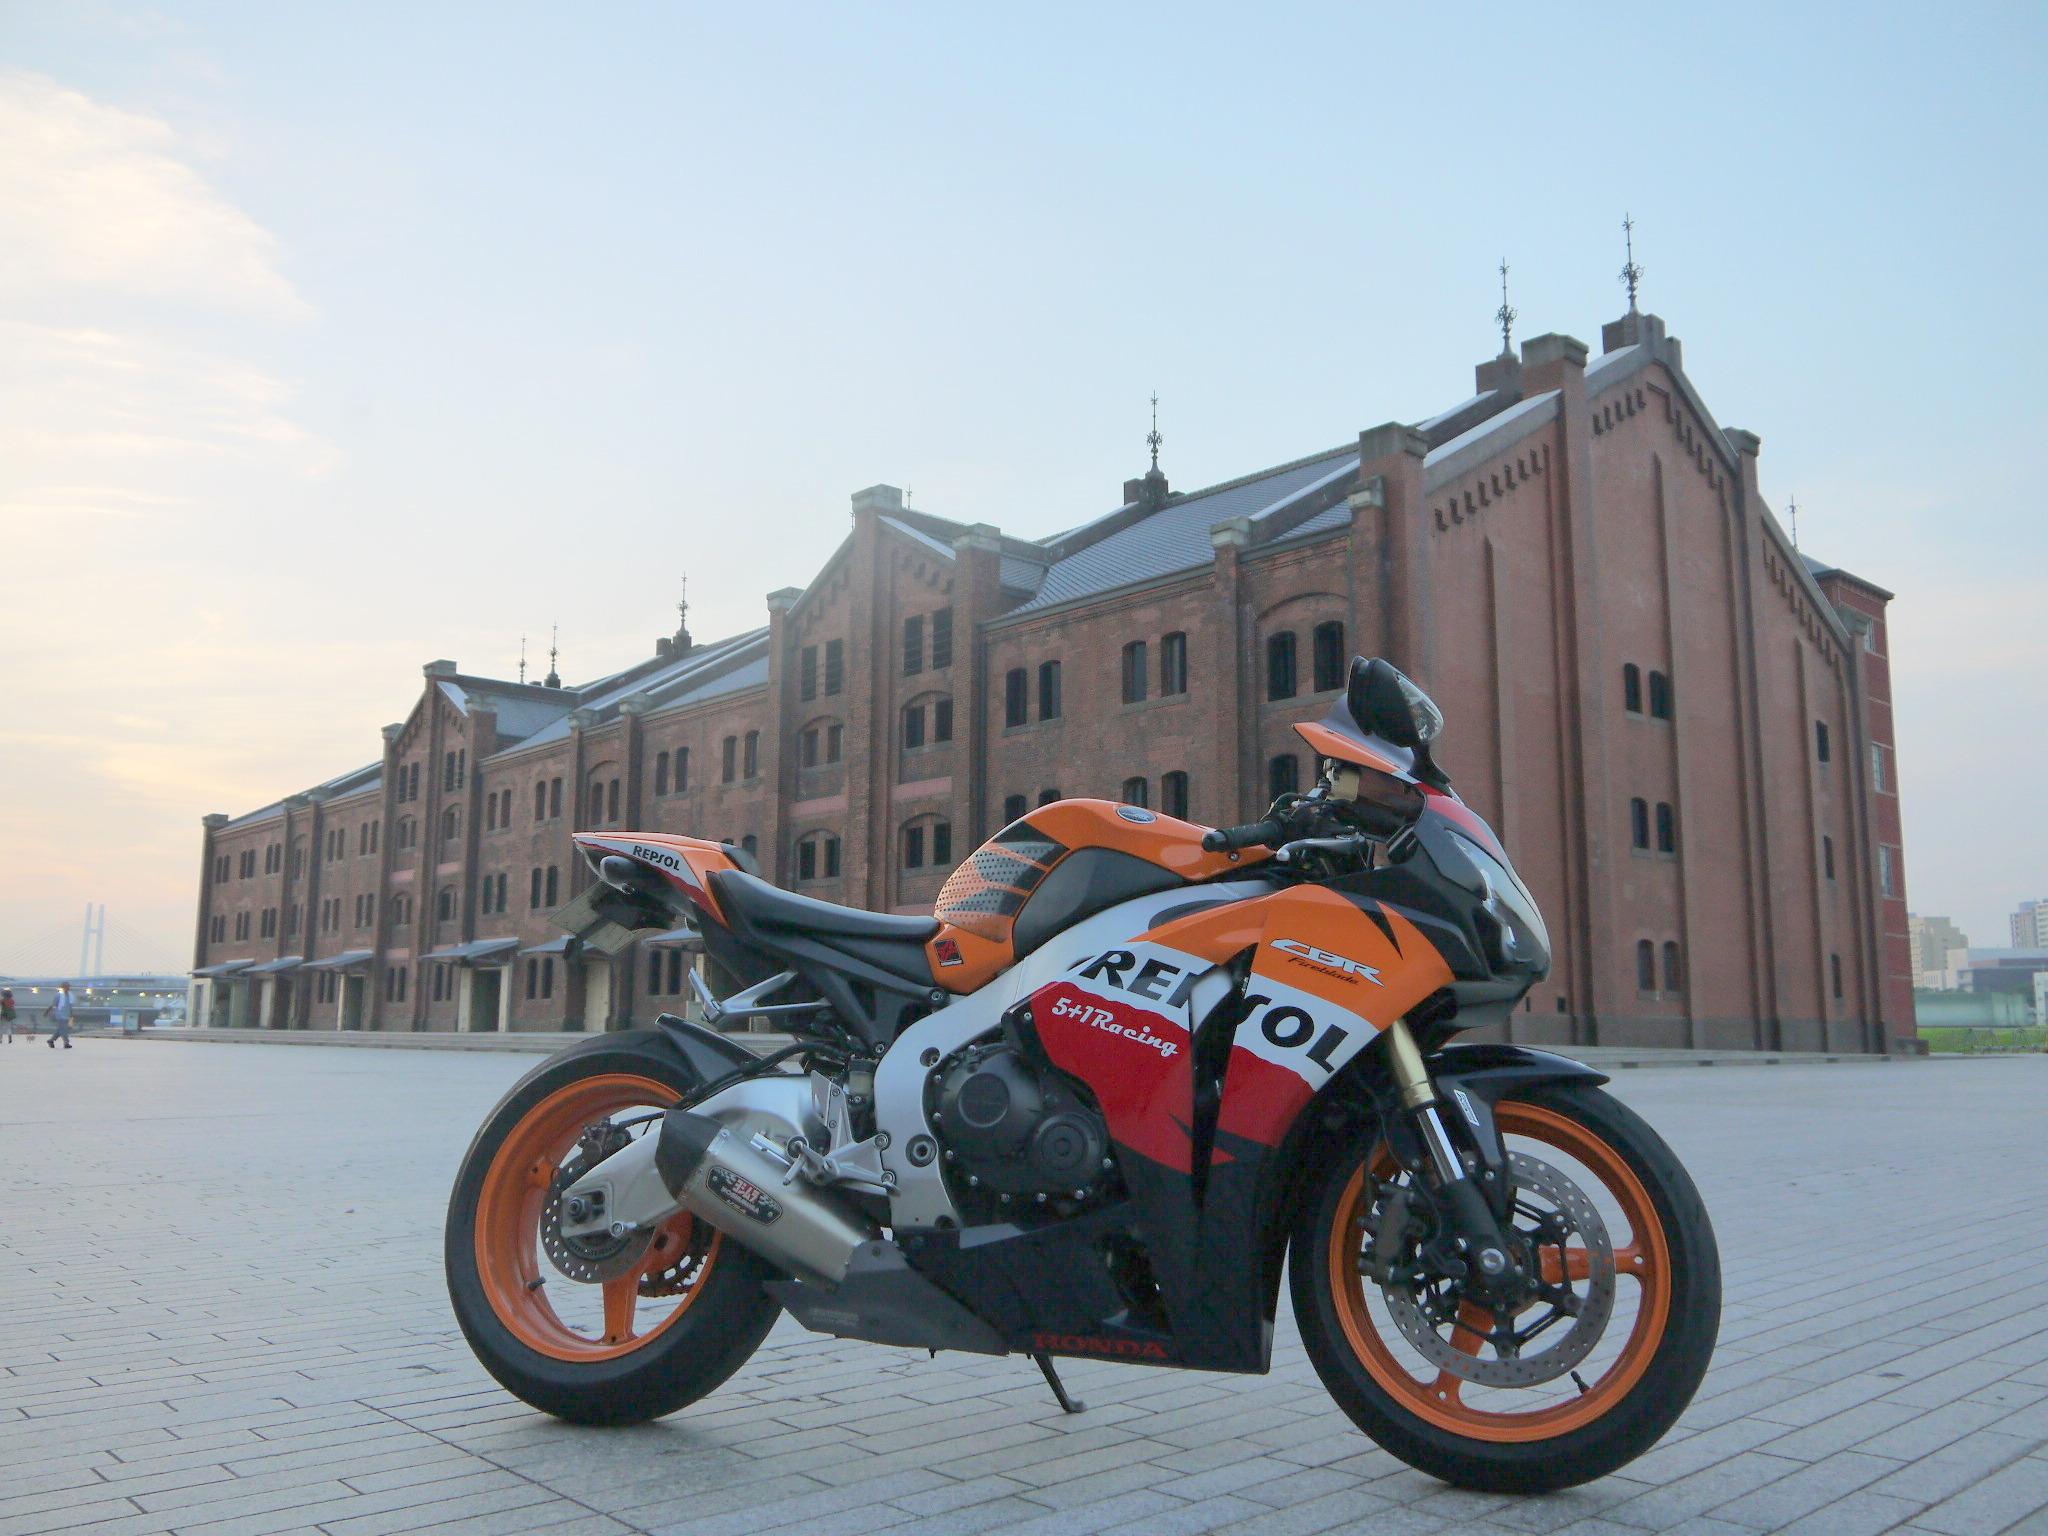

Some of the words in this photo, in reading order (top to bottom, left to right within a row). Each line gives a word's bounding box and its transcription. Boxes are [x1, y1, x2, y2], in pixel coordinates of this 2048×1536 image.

[633, 845, 680, 871] REPSOL
[1270, 938, 1385, 987] CBR
[1288, 957, 1360, 985] Fireblade
[1034, 1332, 1168, 1359] HONDA
